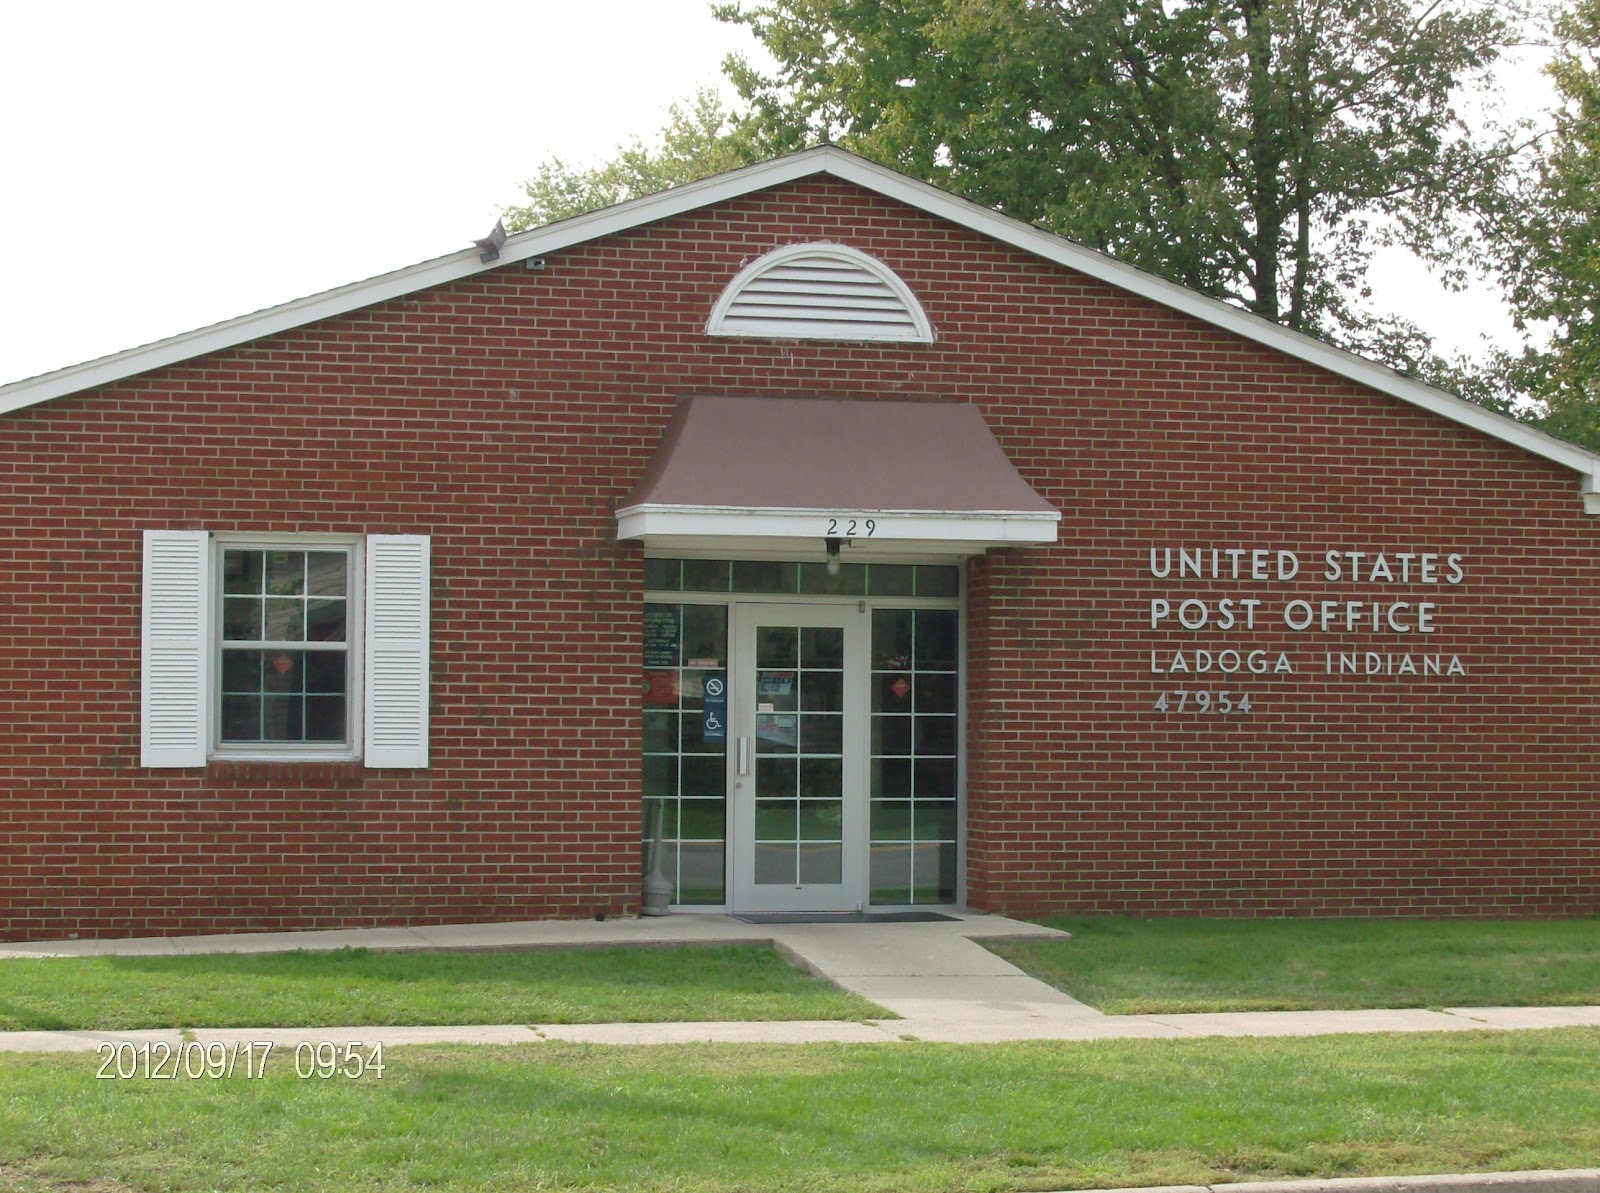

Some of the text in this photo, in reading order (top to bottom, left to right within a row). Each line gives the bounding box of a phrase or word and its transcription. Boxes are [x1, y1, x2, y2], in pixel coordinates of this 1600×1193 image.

[827, 518, 876, 537] 229
[1150, 547, 1464, 585] UNITED STATES
[1150, 598, 1436, 633] POST OFFICE
[1150, 649, 1466, 676] LADOGA INDIANA
[1153, 690, 1253, 714] 47954
